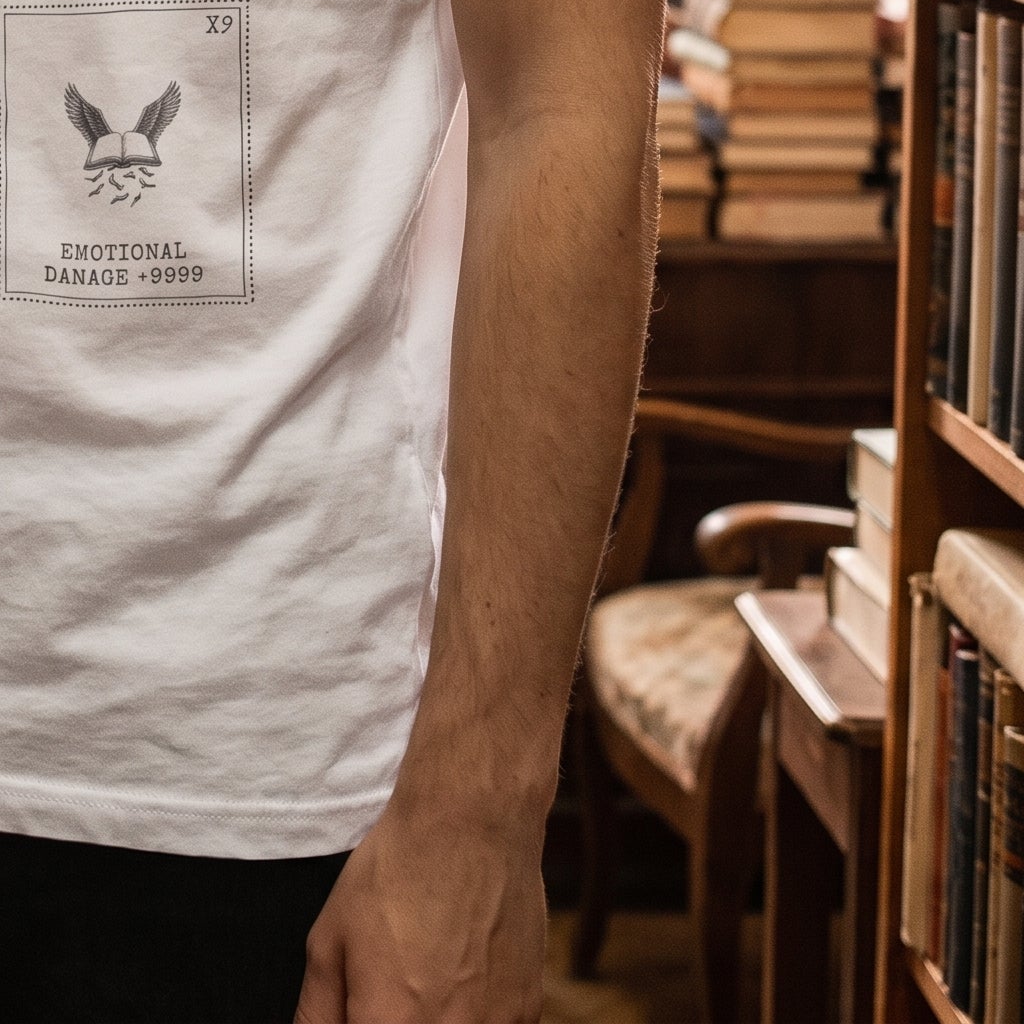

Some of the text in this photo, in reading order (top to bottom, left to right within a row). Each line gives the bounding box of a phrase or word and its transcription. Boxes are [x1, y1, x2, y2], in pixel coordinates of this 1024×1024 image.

[205, 15, 233, 34] X9
[60, 241, 187, 261] EMOTIONAL
[44, 265, 204, 286] DANAGE +9999
